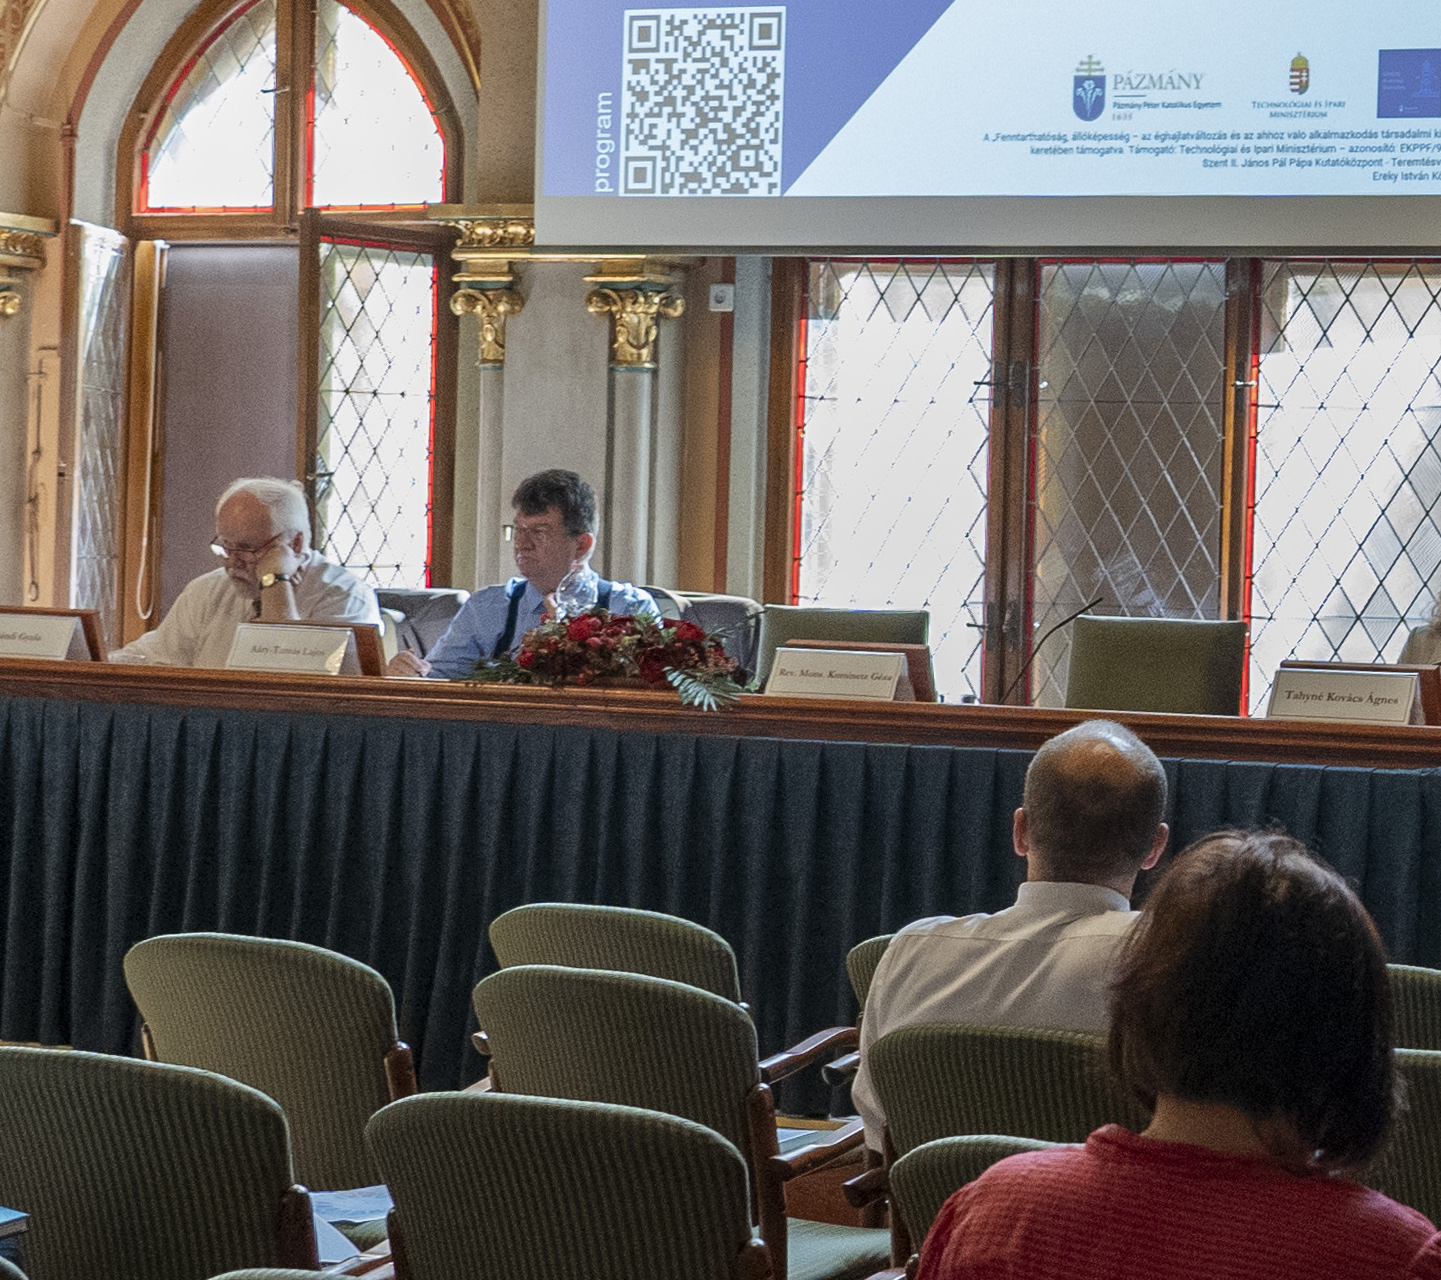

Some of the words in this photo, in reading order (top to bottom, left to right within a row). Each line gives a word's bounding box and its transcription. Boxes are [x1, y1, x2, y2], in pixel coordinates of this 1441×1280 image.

[1113, 69, 1206, 90] PÁZMÁNY
[983, 132, 990, 141] A
[1141, 132, 1151, 141] az
[1230, 130, 1240, 140] és
[1243, 132, 1254, 140] az
[1257, 130, 1285, 140] ahhoz
[1309, 129, 1378, 139] alkalmazkodás
[1381, 128, 1431, 139] társadalmi
[595, 92, 616, 192] program
[1030, 146, 1073, 155] keretében
[1179, 144, 1237, 156] Technológiai
[1240, 145, 1250, 154] és
[1253, 144, 1274, 155] Ipari
[1276, 144, 1337, 154] Minisztérium
[1202, 158, 1228, 168] Szent
[1241, 157, 1269, 168] János
[1272, 158, 1287, 167] Pál
[1289, 158, 1312, 169] Pápa
[1315, 157, 1383, 169] Kutatóközpont
[1372, 171, 1398, 183] Ereky
[1401, 170, 1430, 180] István
[1285, 690, 1325, 704] Tahyné
[1326, 692, 1363, 703] Kovács
[1365, 692, 1399, 707] Ágnes
